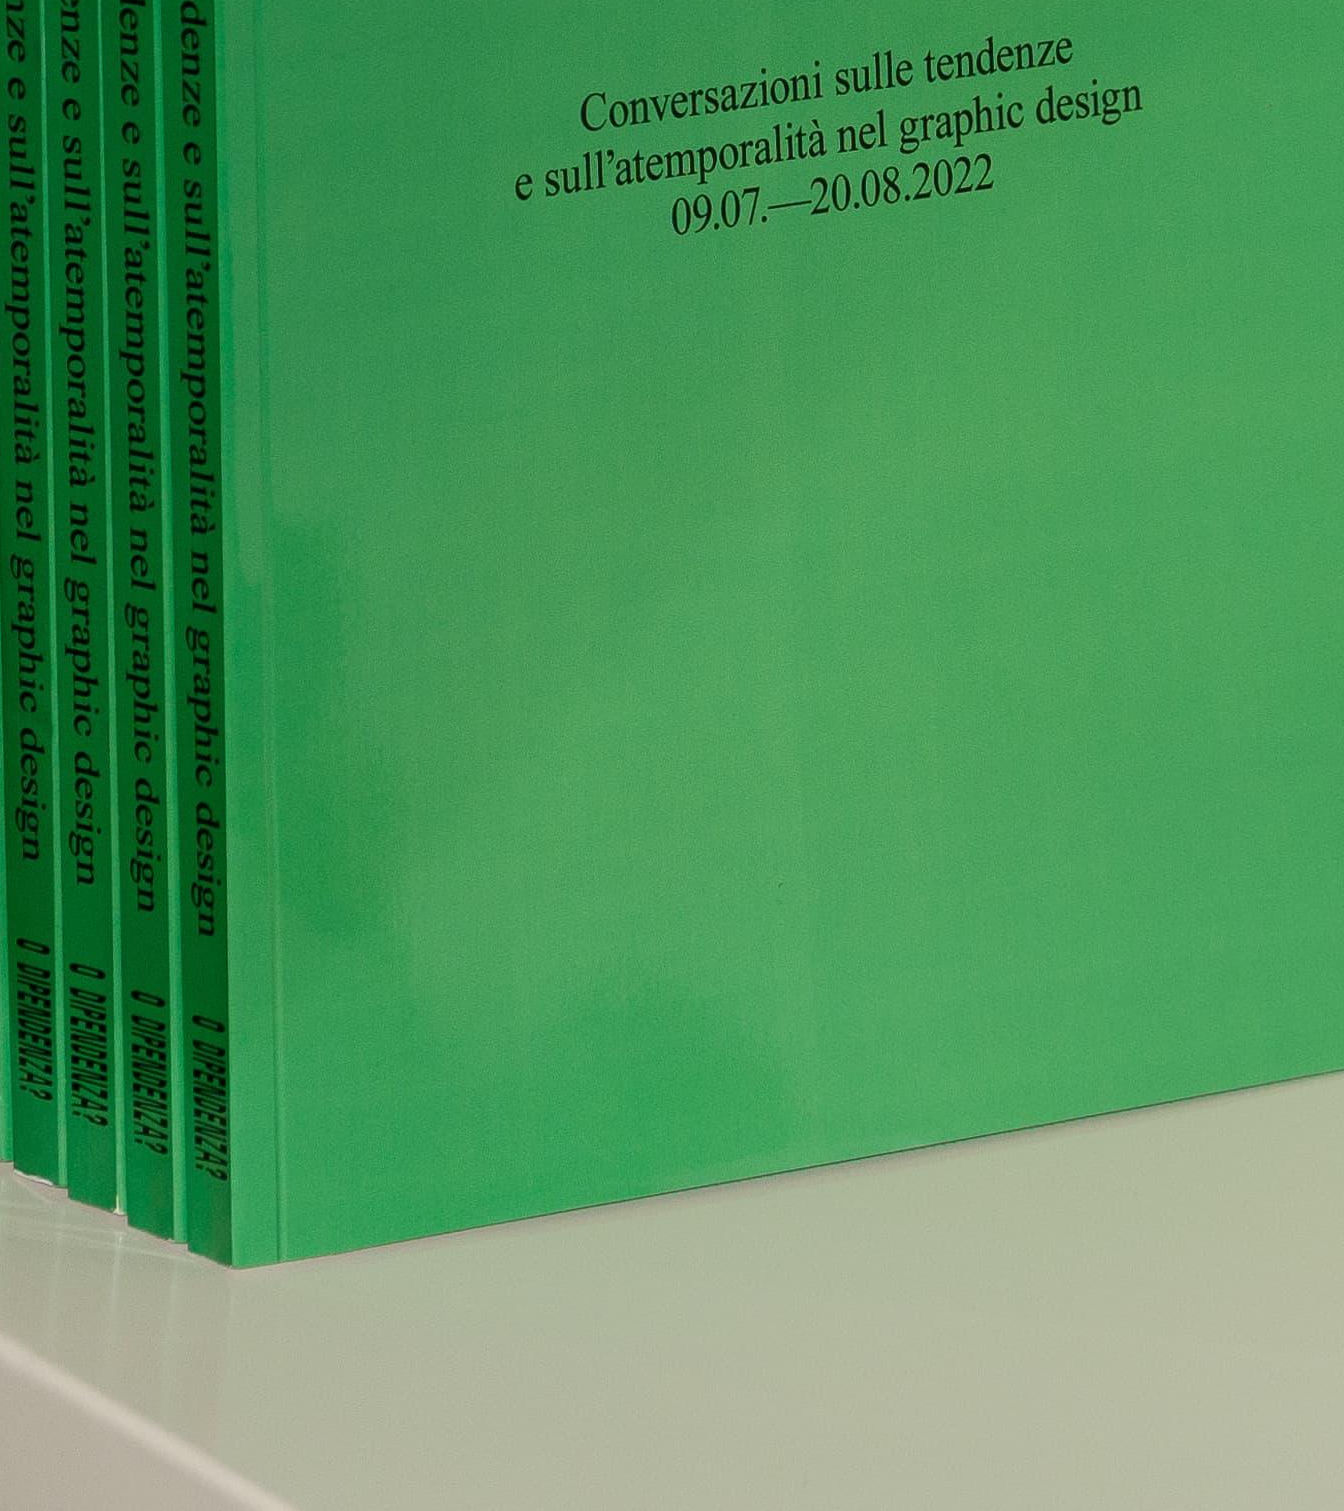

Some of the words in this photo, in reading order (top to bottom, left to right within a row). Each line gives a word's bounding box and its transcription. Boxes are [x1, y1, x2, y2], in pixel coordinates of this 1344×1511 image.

[7, 76, 26, 100] e
[62, 98, 81, 122] e
[120, 120, 141, 145] e
[513, 171, 534, 202] e
[836, 108, 888, 155] nel
[898, 90, 1025, 154] graphic
[1035, 76, 1145, 128] design
[579, 60, 823, 132] Conversazioni
[834, 50, 914, 97] sulle
[925, 34, 1075, 85] tendenze
[182, 141, 203, 166] e
[15, 479, 42, 542] nel
[70, 502, 98, 566] nel
[128, 528, 157, 591] nel
[9, 554, 45, 713] graphic
[190, 551, 218, 615] nel
[63, 577, 100, 737] graphic
[124, 603, 160, 766] graphic
[185, 626, 220, 788] graphic
[15, 725, 47, 862] design
[68, 749, 102, 887] design
[129, 776, 162, 915] design
[190, 799, 222, 937] design
[15, 937, 50, 956] O
[69, 962, 106, 981] O
[130, 989, 166, 1009] O
[16, 961, 54, 1102] DIPENDENZA?
[69, 987, 109, 1128] DIPENDENZA?
[191, 1014, 226, 1034] O
[130, 1014, 169, 1156] DIPENDENZA?
[191, 1038, 228, 1182] DIPENDENZA?
